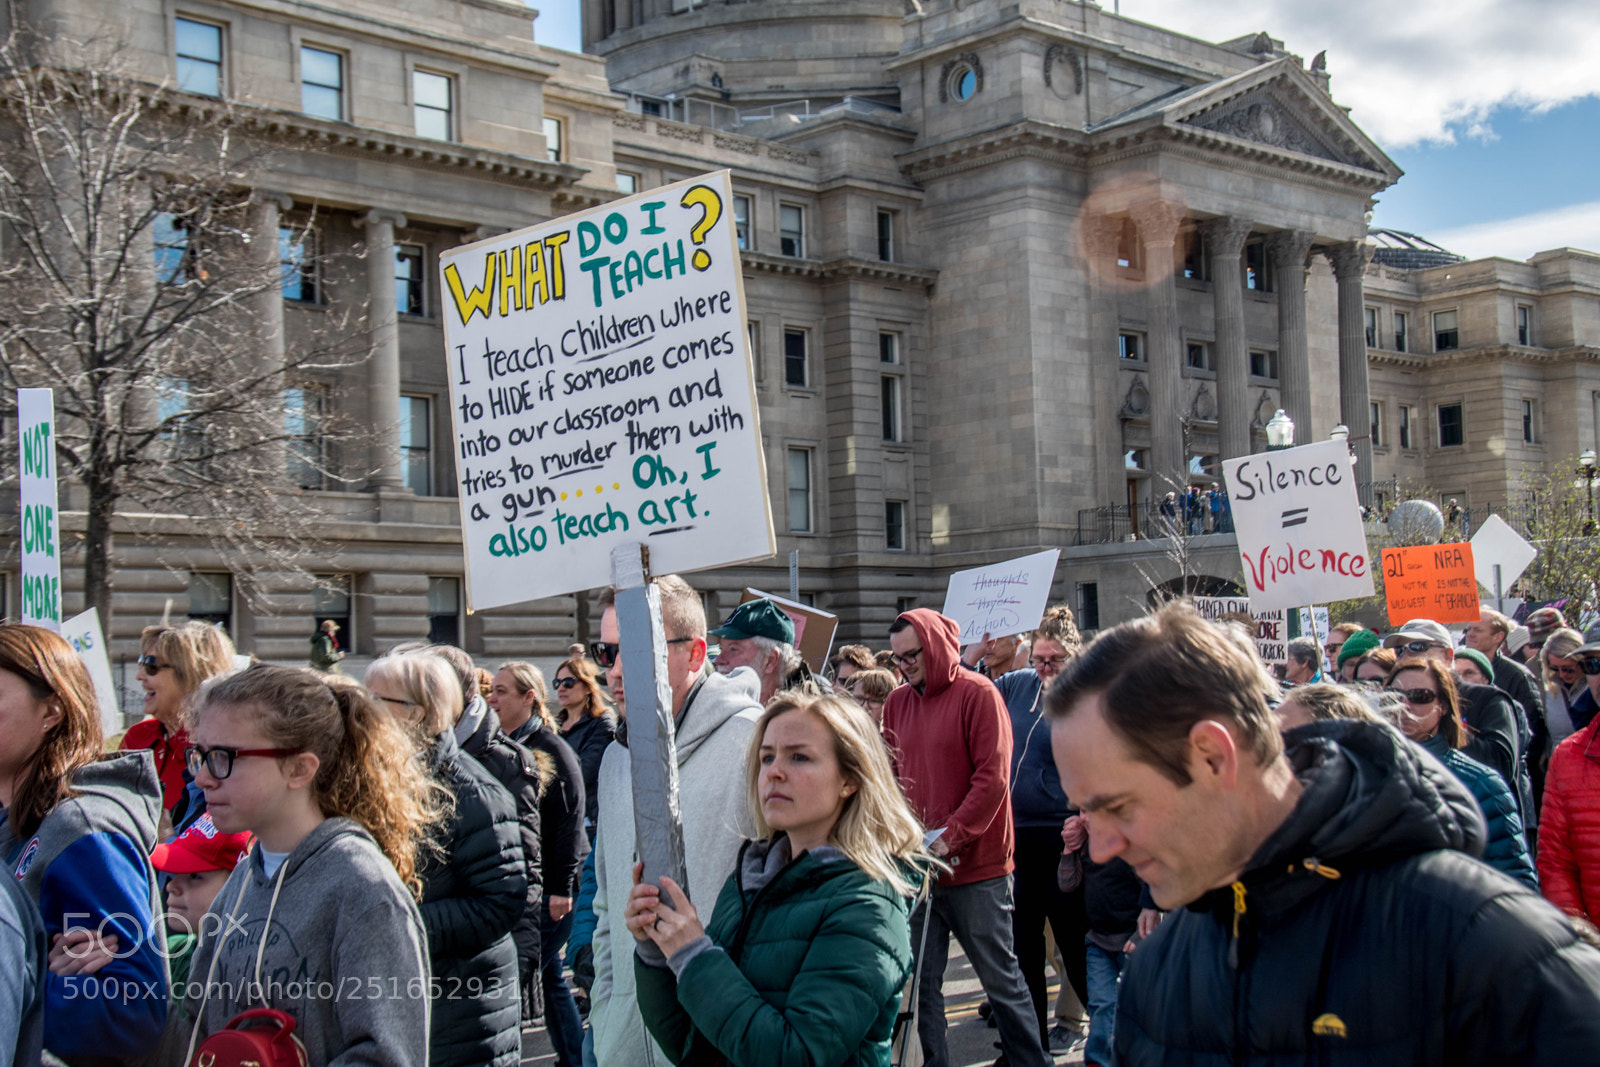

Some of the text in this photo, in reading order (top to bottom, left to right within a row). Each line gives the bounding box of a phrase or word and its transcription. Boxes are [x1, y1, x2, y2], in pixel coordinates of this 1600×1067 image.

[444, 201, 666, 326] WHAT DO I
[456, 344, 470, 385] I
[483, 337, 554, 380] teach
[660, 290, 731, 328] where
[459, 331, 734, 423] to HIDE if someone comes
[460, 368, 723, 459] into our classroom and
[23, 422, 50, 479] NOT
[462, 406, 744, 496] tries to murder them with
[471, 503, 490, 522] a
[632, 454, 688, 489] Oh,
[696, 441, 721, 480] I
[1235, 460, 1342, 500] Silence
[23, 504, 54, 558] ONE
[488, 488, 711, 558] also teach art.
[1281, 507, 1309, 528] =
[1242, 542, 1366, 592] Violence
[1434, 548, 1465, 570] NRA
[1437, 579, 1446, 589] IS
[23, 572, 59, 623] MORE
[1407, 596, 1426, 608] WEST
[1446, 593, 1477, 609] BRANCH
[964, 616, 1010, 638] Action
[1255, 621, 1281, 640] ORE
[1257, 642, 1285, 660] ORROR
